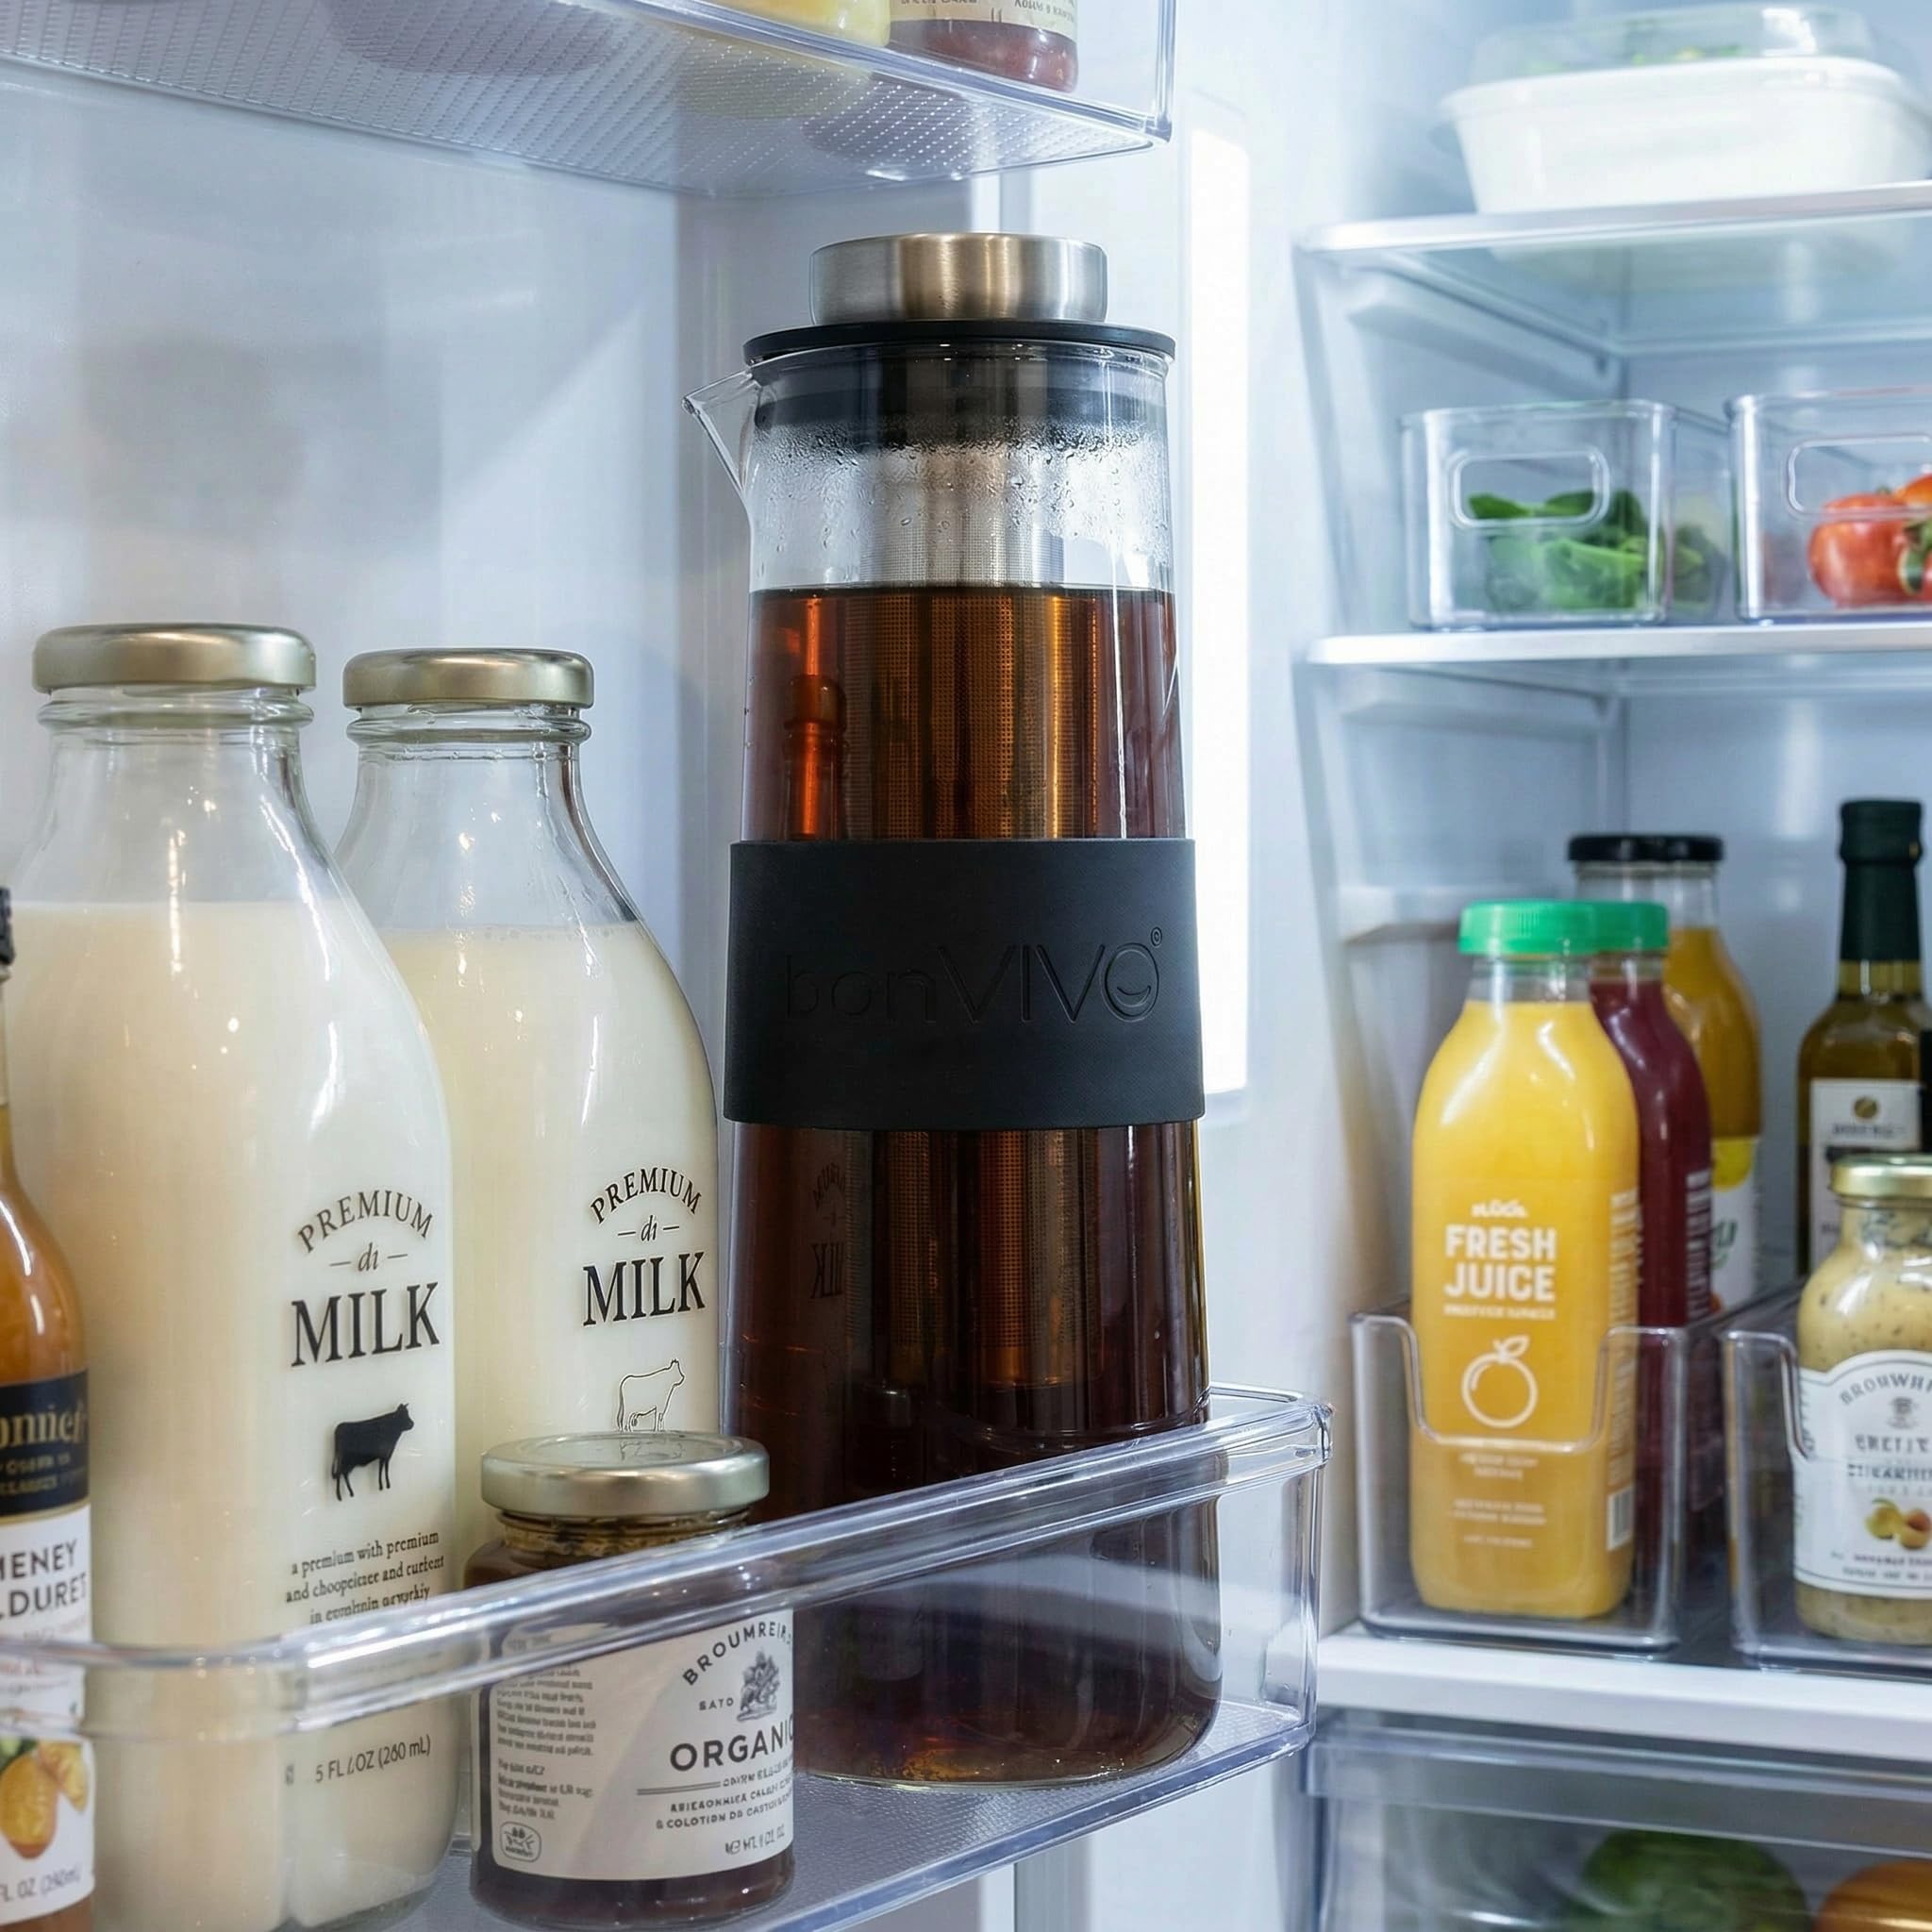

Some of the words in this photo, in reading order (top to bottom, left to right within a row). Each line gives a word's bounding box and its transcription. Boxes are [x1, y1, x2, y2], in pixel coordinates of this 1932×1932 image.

[590, 1167, 702, 1224] PREMIUM
[297, 1190, 434, 1254] PREMIUM
[1444, 1224, 1557, 1261] FRESH
[583, 1251, 706, 1326] MILK
[1443, 1261, 1556, 1303] JUICE
[291, 1281, 440, 1368] MILK
[382, 1561, 404, 1582] and
[315, 1763, 324, 1783] 5
[328, 1758, 344, 1780] FL
